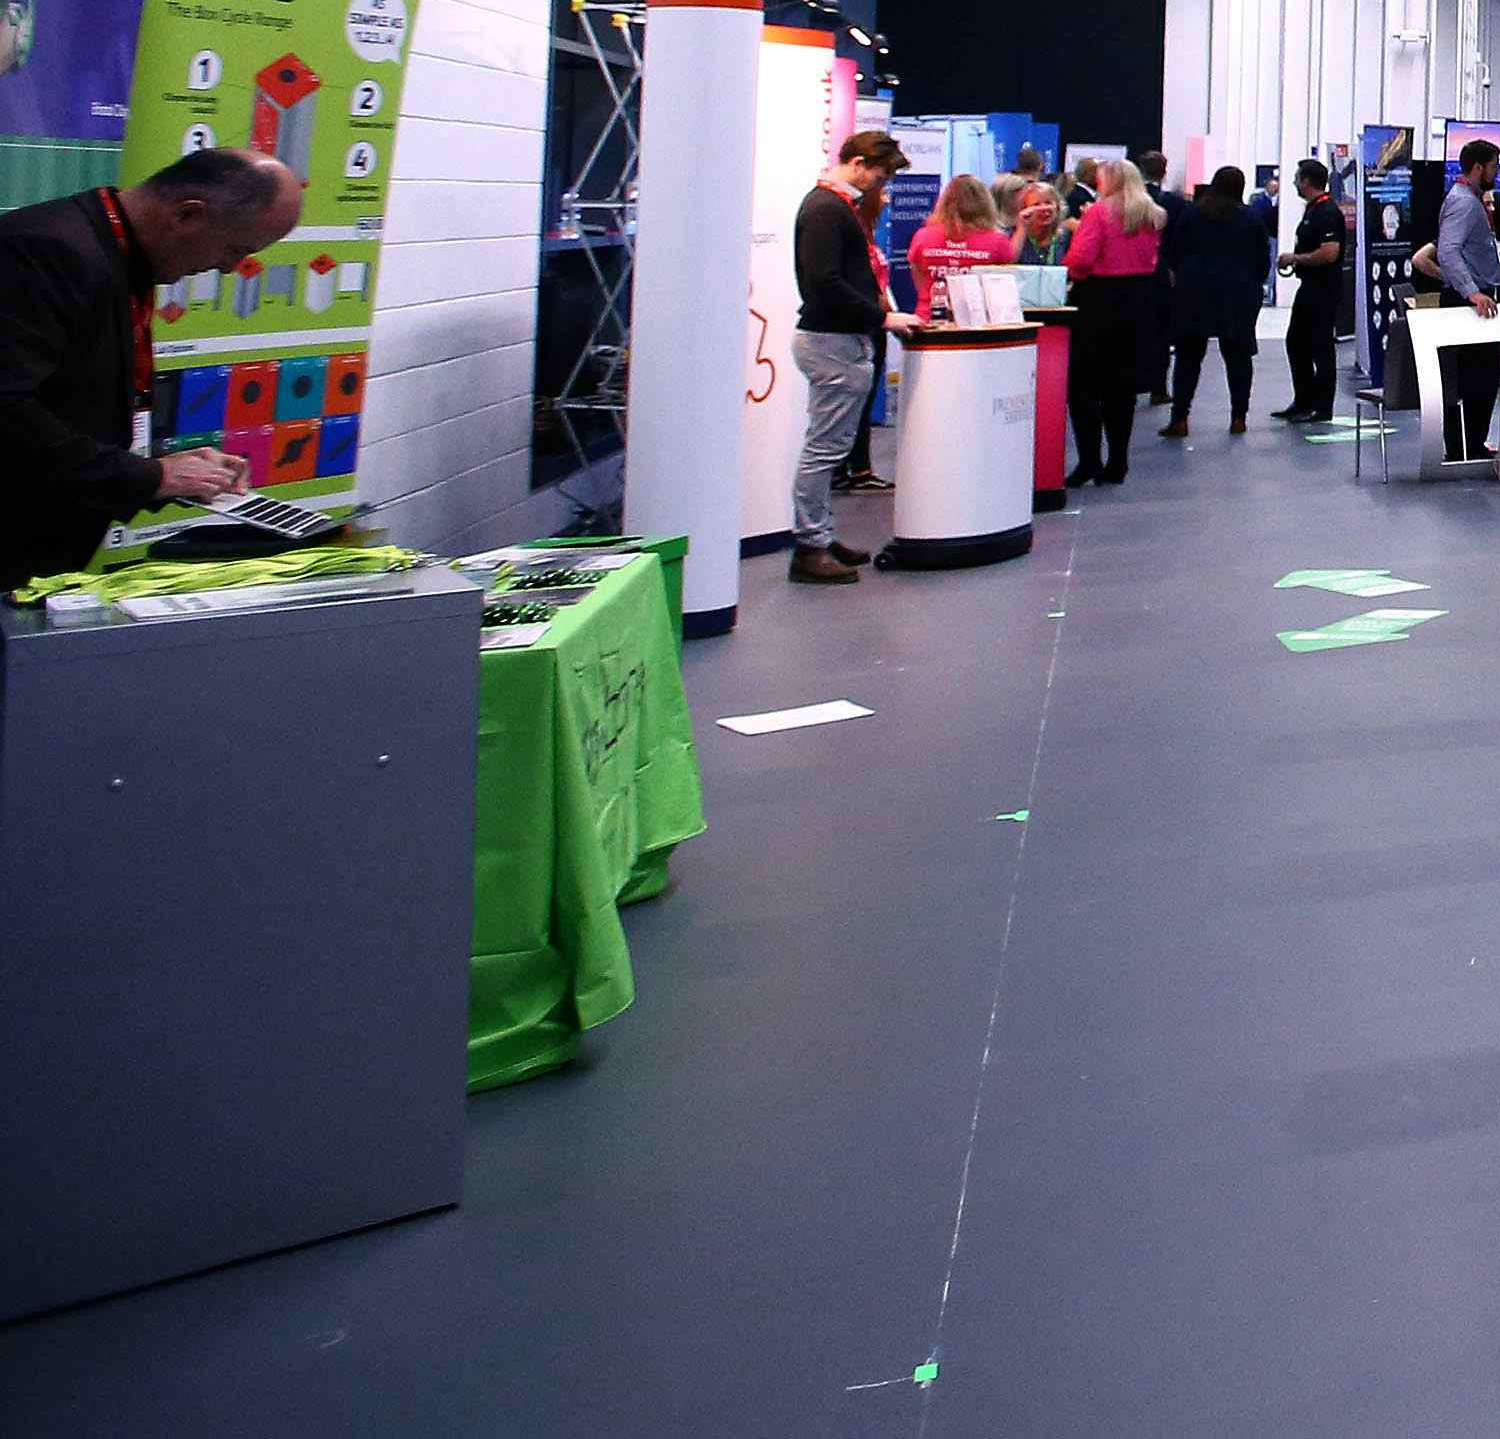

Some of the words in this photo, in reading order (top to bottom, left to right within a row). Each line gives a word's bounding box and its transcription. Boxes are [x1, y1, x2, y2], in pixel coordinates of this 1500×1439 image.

[164, 0, 192, 19] The
[194, 4, 222, 22] Box
[222, 8, 255, 28] Cycle
[255, 12, 294, 31] Range
[199, 58, 210, 82] 1
[360, 86, 374, 110] 2
[351, 148, 369, 171] 4
